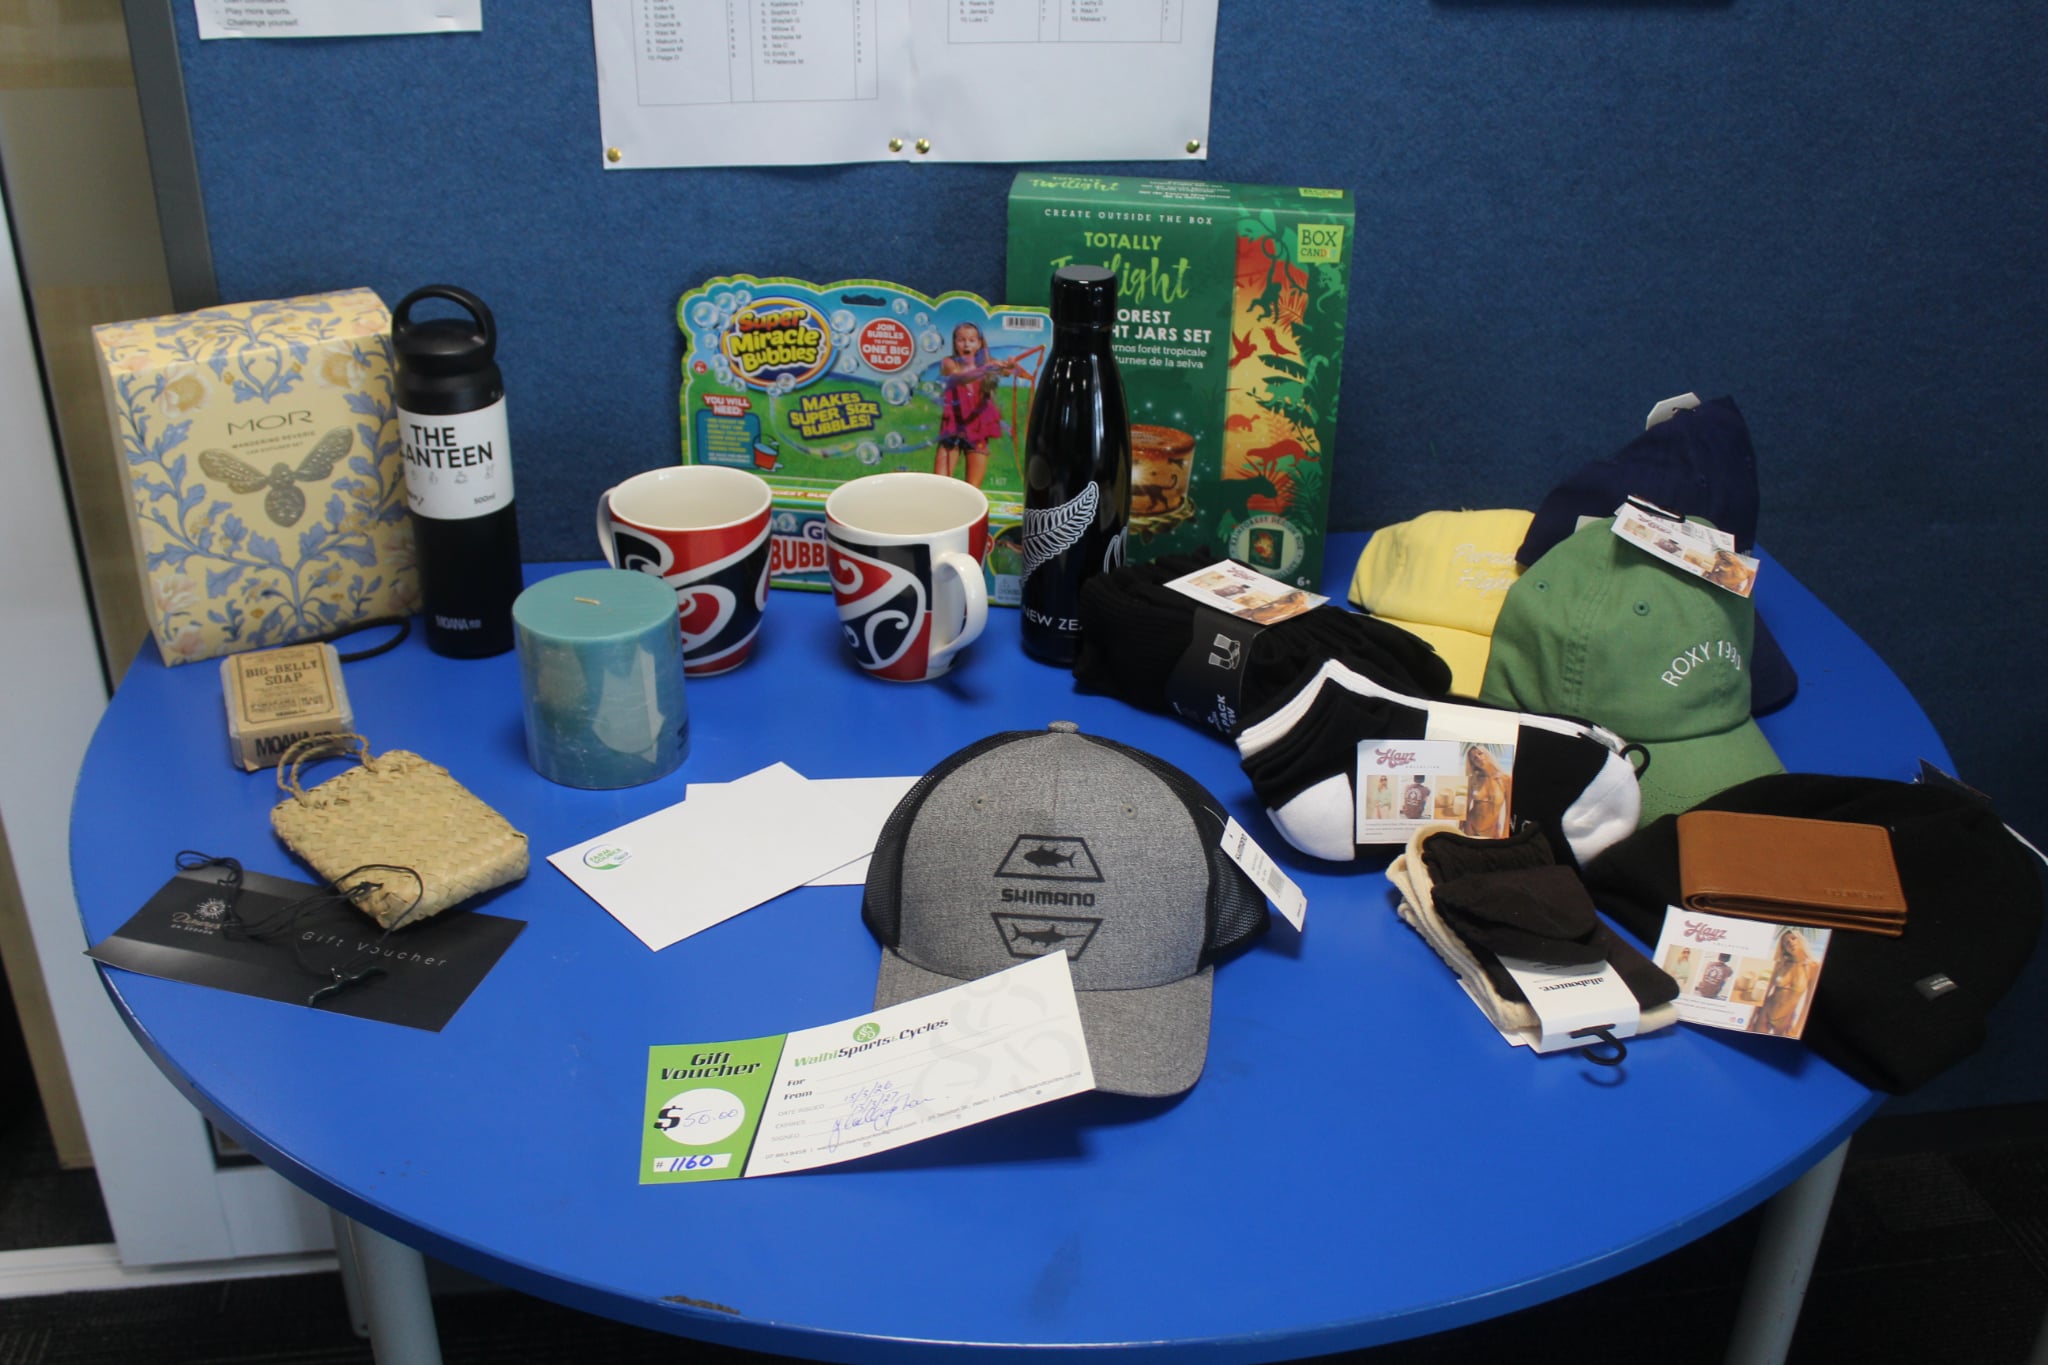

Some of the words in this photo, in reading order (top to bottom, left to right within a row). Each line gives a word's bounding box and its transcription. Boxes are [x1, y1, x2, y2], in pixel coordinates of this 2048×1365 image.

[225, 8, 242, 16] Play
[1044, 208, 1091, 218] CREATE
[1097, 210, 1152, 222] OUTSIDE
[1159, 214, 1182, 224] THE
[1189, 216, 1213, 225] BOX
[1084, 231, 1162, 251] TOTALLY
[1301, 229, 1338, 247] BOX
[738, 309, 807, 331] Super
[1116, 308, 1171, 325] OREST
[867, 330, 904, 340] BUBBLES
[876, 324, 896, 332] JOIN
[1112, 325, 1129, 339] HT
[1134, 327, 1178, 342] JARS
[1183, 329, 1212, 344] SET
[729, 326, 820, 356] Miracle
[862, 344, 887, 354] ONE
[889, 346, 910, 356] BIG
[742, 344, 818, 372] Bubbles
[870, 354, 902, 365] BLOB
[1163, 346, 1207, 358] tropicale
[1114, 355, 1147, 366] turnes
[1149, 356, 1163, 366] de
[1164, 356, 1175, 367] la
[1176, 357, 1203, 369] selva
[703, 394, 725, 406] YOU
[726, 396, 750, 408] WILL
[801, 393, 861, 412] MAKES
[227, 410, 314, 436] MOR
[790, 407, 841, 427] SUPER
[845, 402, 880, 416] SIZE
[802, 414, 872, 438] BUBBLES!
[410, 424, 457, 448] THE
[771, 538, 826, 571] BUBB
[1297, 576, 1311, 587] 6+
[1022, 604, 1053, 627] NEW
[245, 660, 318, 679] BIG-BELLY
[1661, 641, 1711, 687] ROXY
[264, 672, 303, 687] SOAP
[1001, 888, 1097, 907] SHIMANO
[301, 931, 344, 948] Gift
[357, 942, 448, 967] Voucher
[691, 1052, 731, 1066] Gift
[661, 1062, 761, 1080] Voucher
[787, 1078, 806, 1087] For
[783, 1090, 813, 1101] From
[655, 1161, 664, 1169] #
[669, 1154, 714, 1172] 1160
